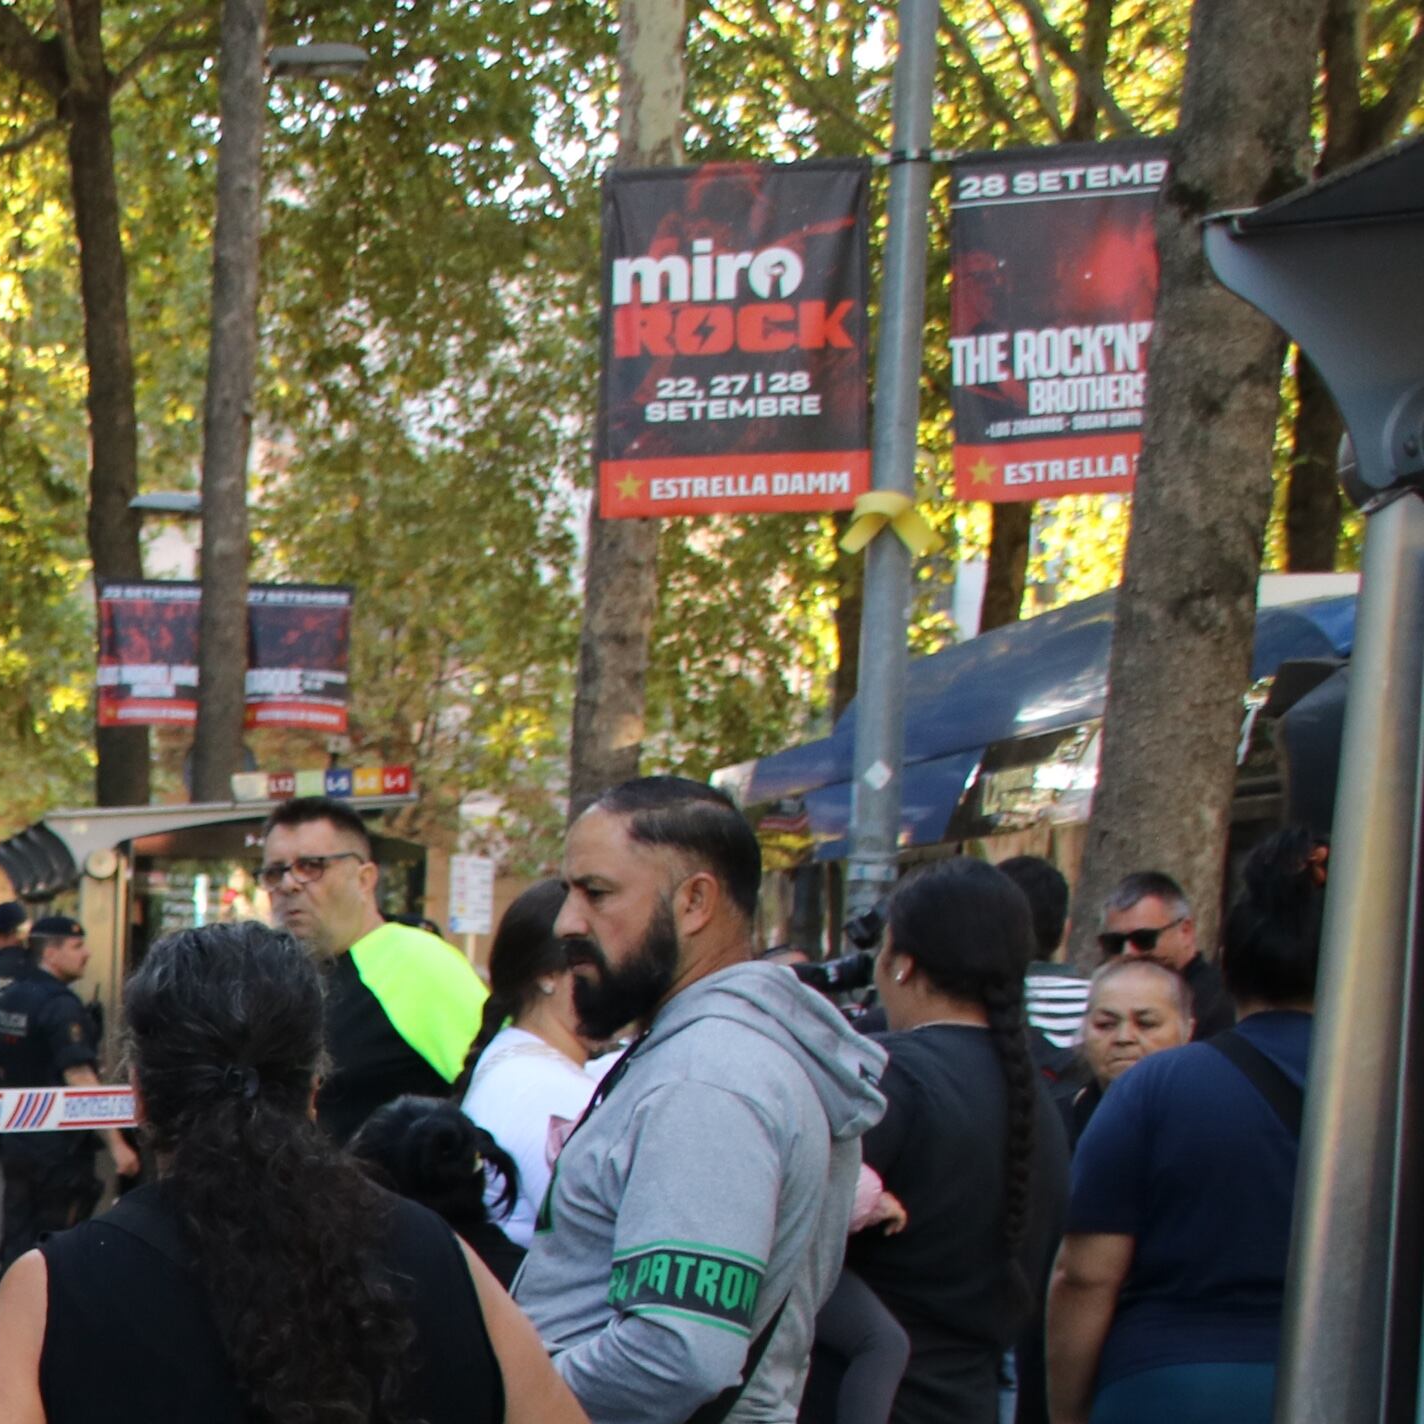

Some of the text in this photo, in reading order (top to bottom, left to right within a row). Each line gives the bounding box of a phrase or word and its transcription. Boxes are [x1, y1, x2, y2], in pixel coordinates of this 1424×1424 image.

[958, 175, 1006, 200] 28
[613, 299, 855, 358] ROCK
[949, 321, 1153, 387] THE ROCK'N'
[656, 371, 811, 400] 22, 27 i 28
[645, 394, 822, 422] SETEMBRE
[1004, 454, 1129, 486] ESTRELLA
[650, 471, 851, 500] ESTRELLA DAMM
[632, 1253, 761, 1314] PATRON
